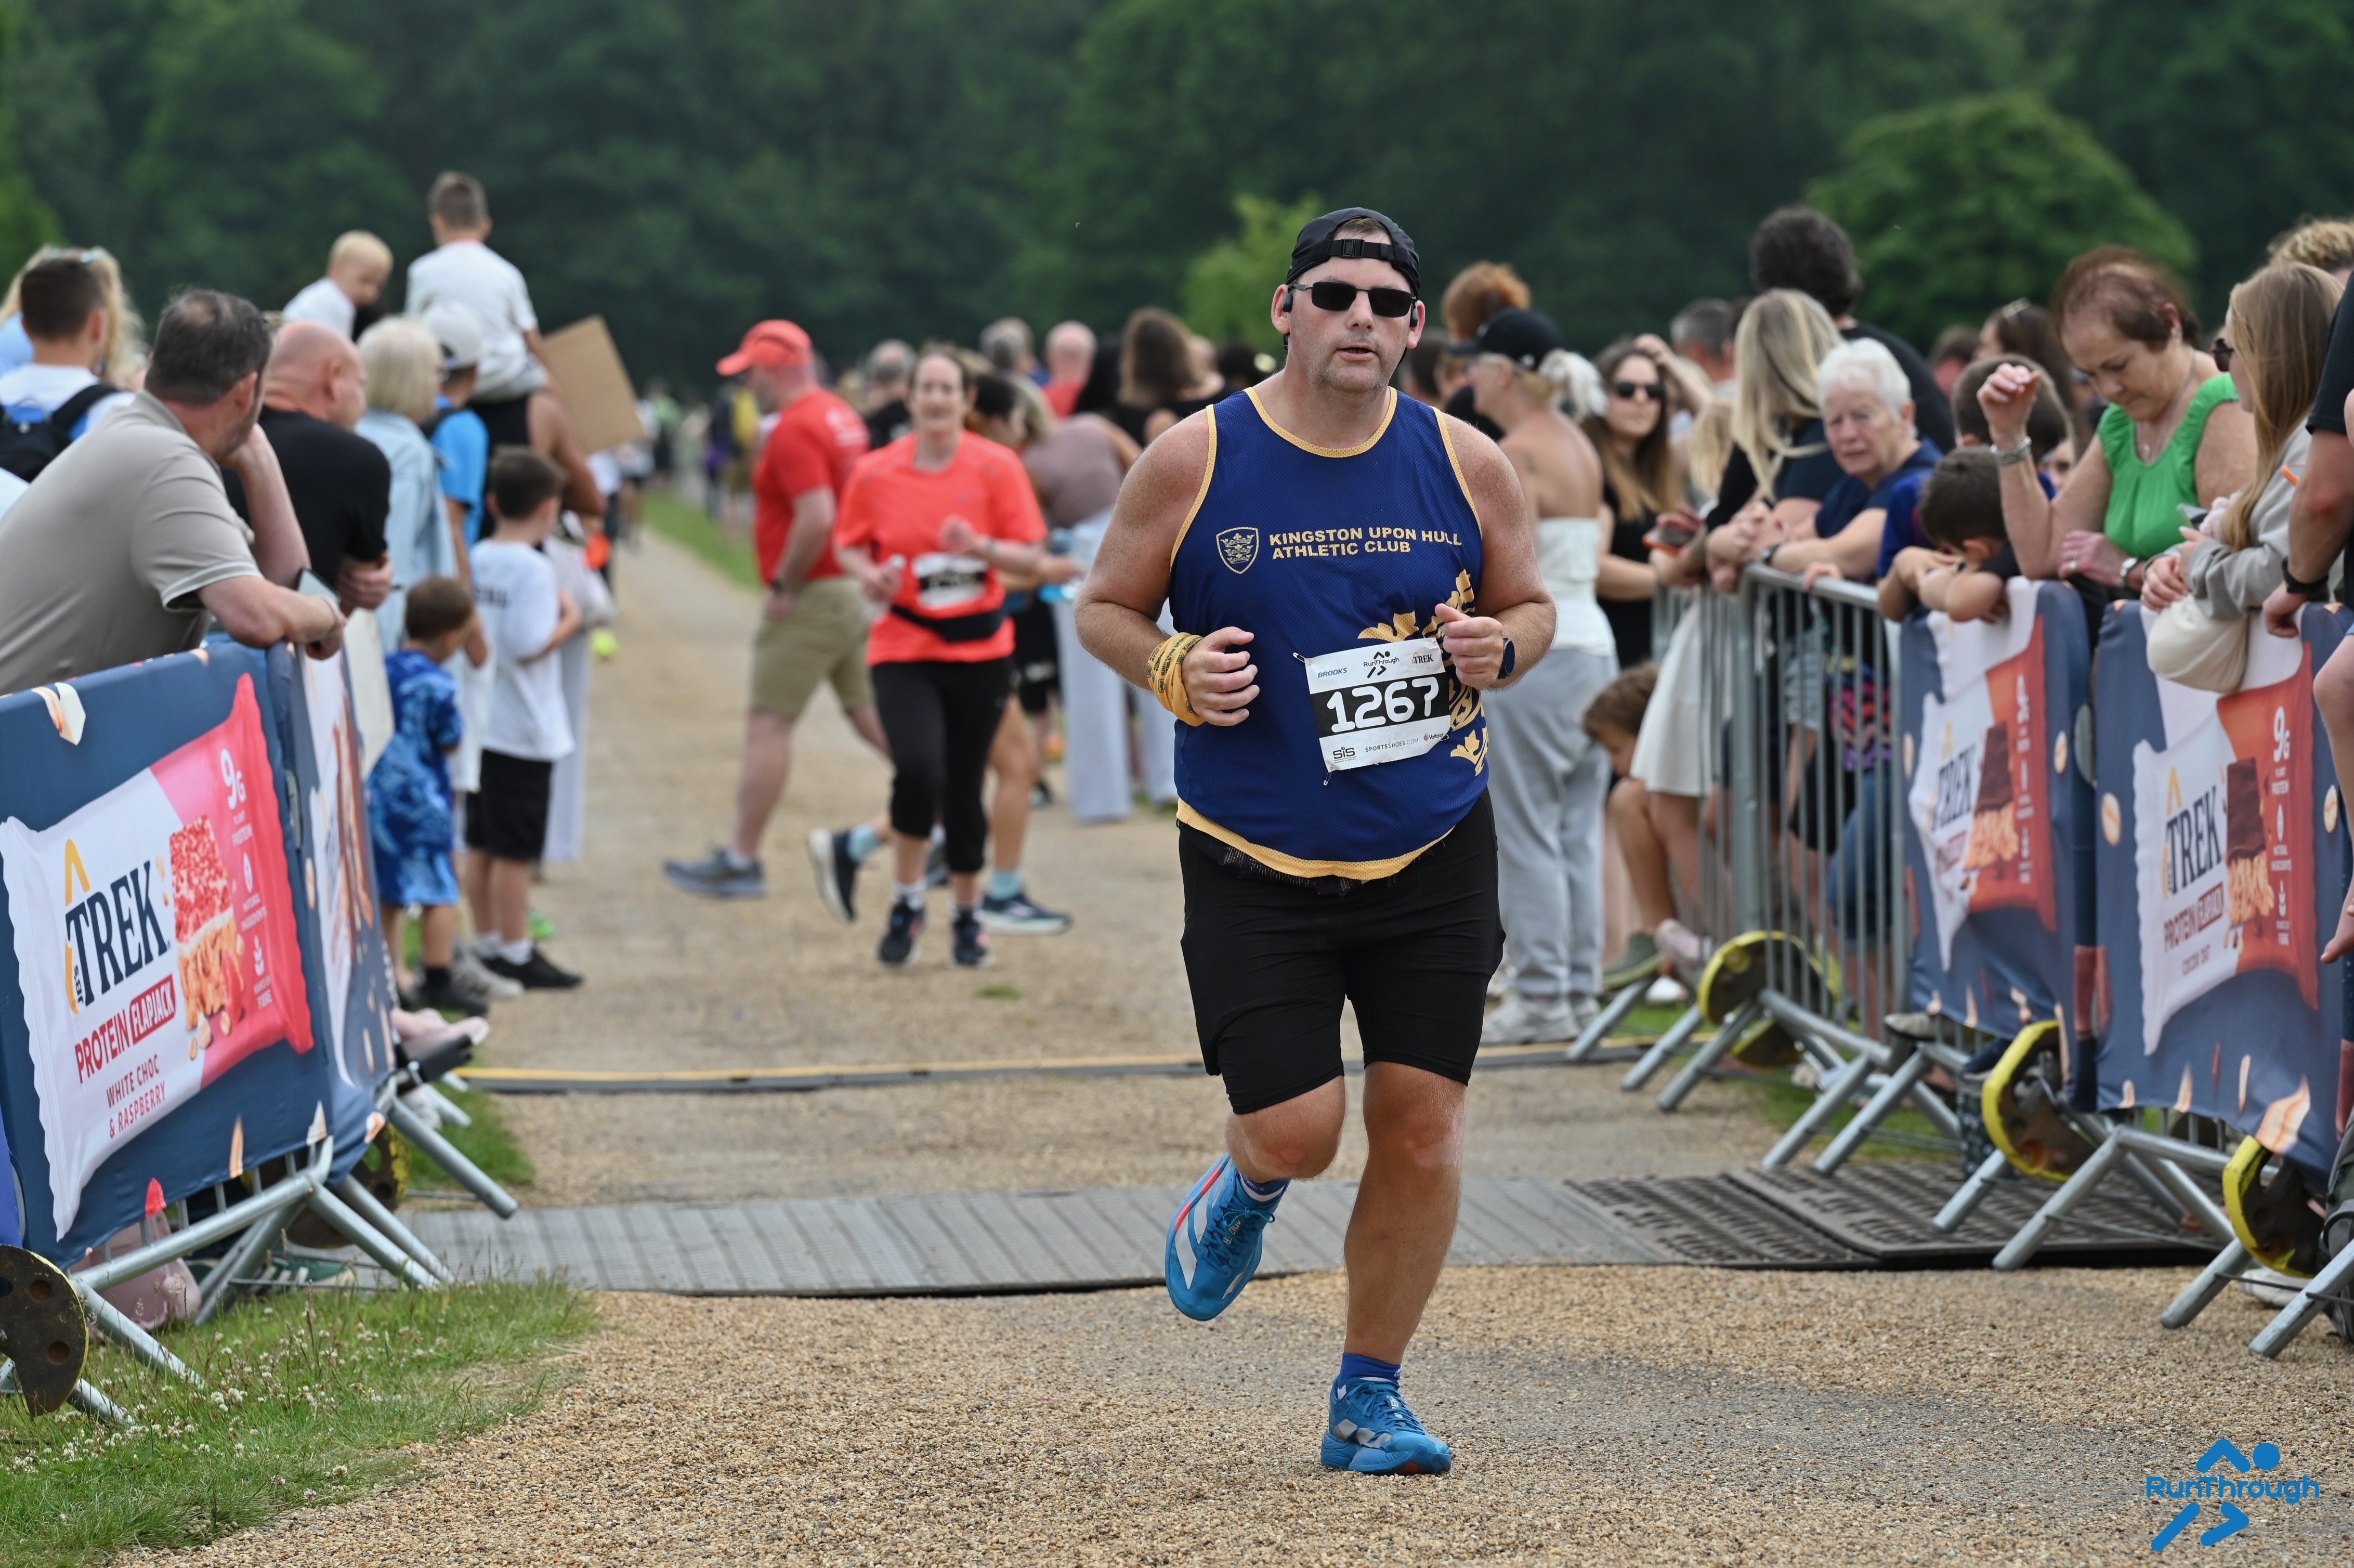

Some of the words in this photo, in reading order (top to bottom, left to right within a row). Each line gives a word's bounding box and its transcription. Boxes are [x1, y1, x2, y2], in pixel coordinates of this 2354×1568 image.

[1270, 527, 1363, 546] KINGSTON
[1369, 527, 1417, 540] UPON
[1421, 530, 1462, 546] HULL
[1272, 542, 1358, 559] ATHLETIC
[1364, 541, 1411, 553] CLUB
[1318, 667, 1348, 678] BROOKS
[1363, 657, 1400, 667] RunThrough
[1413, 654, 1434, 664] TREK
[1327, 676, 1439, 733] 1267
[1365, 738, 1419, 752] SPORTSSHOES.COM
[2166, 785, 2223, 895] TREK
[66, 860, 168, 1007] TREK
[74, 1009, 130, 1084] PROTEIN
[131, 981, 175, 1039] FLAPJACK
[106, 1071, 135, 1108] WHITE
[136, 1054, 160, 1087] CHOC
[109, 1118, 116, 1139] &
[118, 1081, 166, 1132] RASPBERRY
